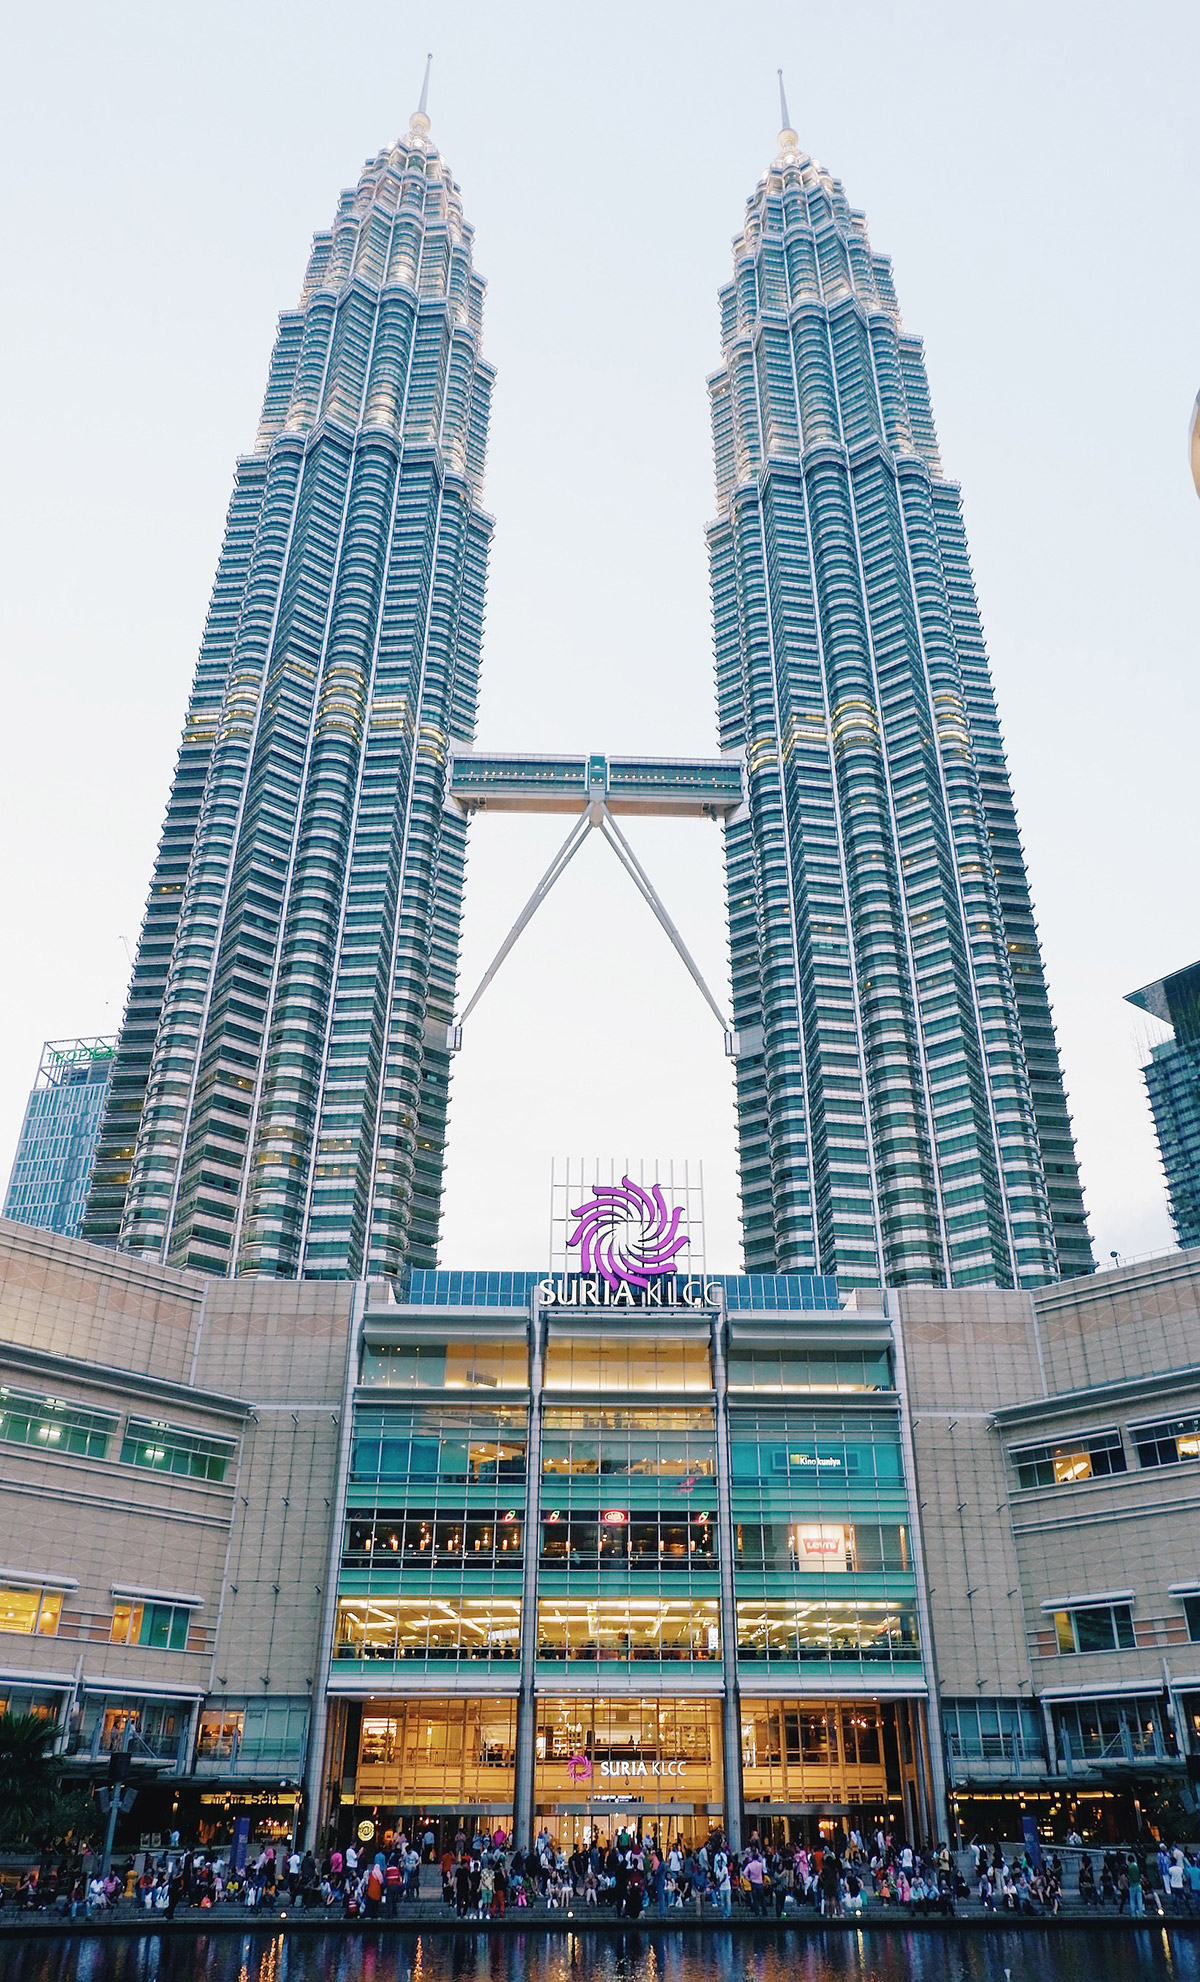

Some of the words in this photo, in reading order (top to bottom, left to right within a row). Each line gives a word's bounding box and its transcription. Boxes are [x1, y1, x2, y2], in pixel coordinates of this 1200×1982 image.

[538, 1278, 636, 1306] SURIA
[647, 1281, 722, 1307] KLCC
[600, 1761, 648, 1776] SURIA
[651, 1761, 687, 1776] KLCC
